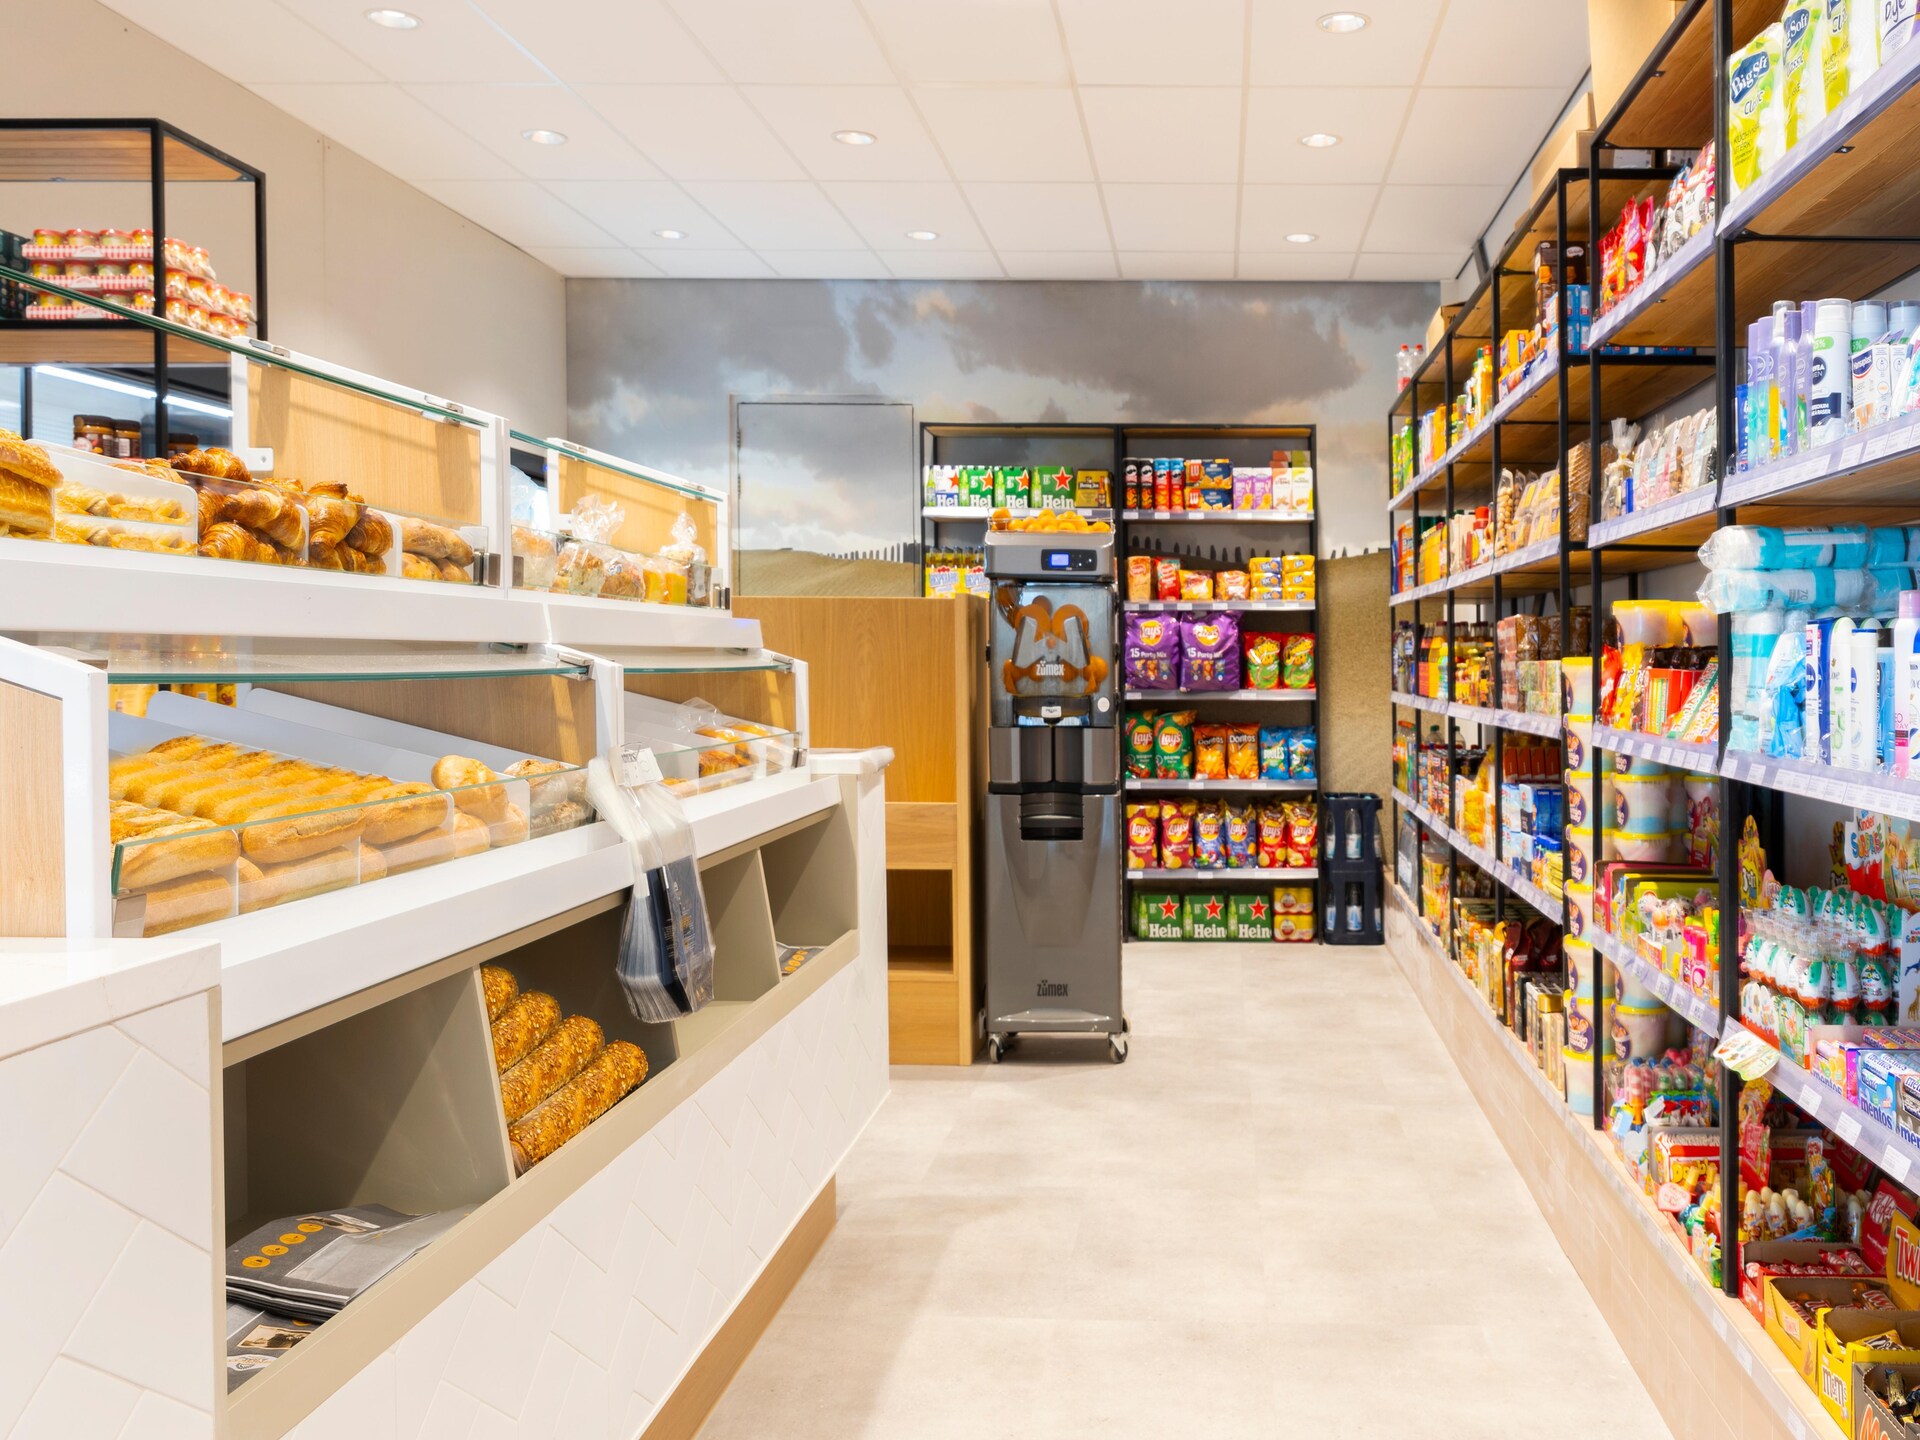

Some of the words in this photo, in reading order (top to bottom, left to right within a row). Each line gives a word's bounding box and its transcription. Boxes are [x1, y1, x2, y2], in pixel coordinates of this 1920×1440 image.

[1790, 13, 1808, 35] Soft
[1731, 70, 1753, 99] Big
[1753, 55, 1768, 77] Sft
[936, 494, 958, 507] Hei
[969, 495, 992, 508] Hei
[1006, 494, 1029, 508] Hei
[1042, 495, 1075, 508] Hein
[1130, 648, 1140, 658] 15
[1140, 651, 1156, 659] Party
[1187, 647, 1197, 657] 15
[1197, 651, 1213, 659] Party
[1134, 732, 1152, 746] Lay's
[1161, 732, 1181, 747] Lay's
[1198, 735, 1224, 745] Doritos
[1229, 734, 1256, 743] Doritos
[1131, 823, 1151, 838] Lay's
[1263, 825, 1281, 839] Lay's
[1294, 825, 1313, 838] Lay's
[1149, 924, 1181, 938] Hein
[1194, 924, 1225, 938] Hein
[1238, 924, 1270, 938] Hein
[1812, 1068, 1843, 1096] mentos
[1860, 1096, 1893, 1130] mentos
